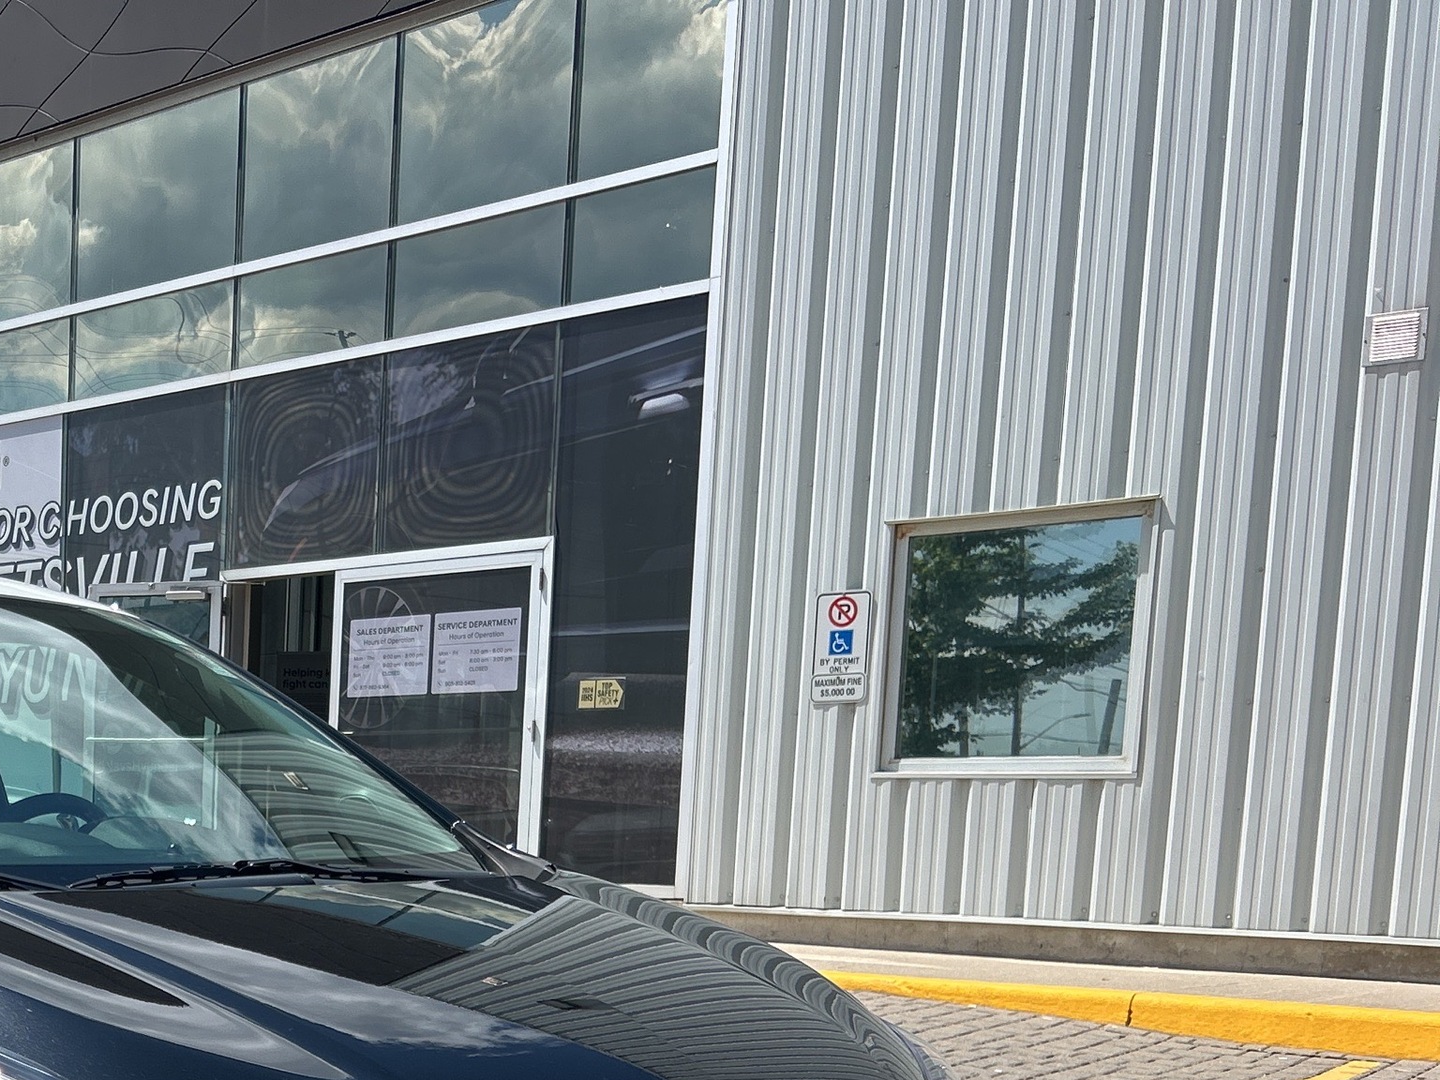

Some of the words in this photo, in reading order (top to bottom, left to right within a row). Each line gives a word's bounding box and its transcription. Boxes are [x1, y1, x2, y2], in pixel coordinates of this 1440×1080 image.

[38, 479, 222, 547] CHOOSING
[437, 621, 467, 630] SERVICE
[468, 618, 517, 629] DEPARTMENT
[356, 627, 377, 636] SALES
[378, 624, 424, 635] DEPARTMENT
[474, 631, 504, 639] Operation
[387, 637, 415, 645] Operation
[820, 658, 830, 667] BY
[833, 657, 860, 665] PERMIT
[283, 668, 323, 678] Helping
[829, 666, 850, 674] ONLY
[282, 679, 307, 690] fight
[814, 678, 845, 687] MAXIMUM
[847, 677, 862, 686] FINE
[597, 689, 619, 697] SAFETY
